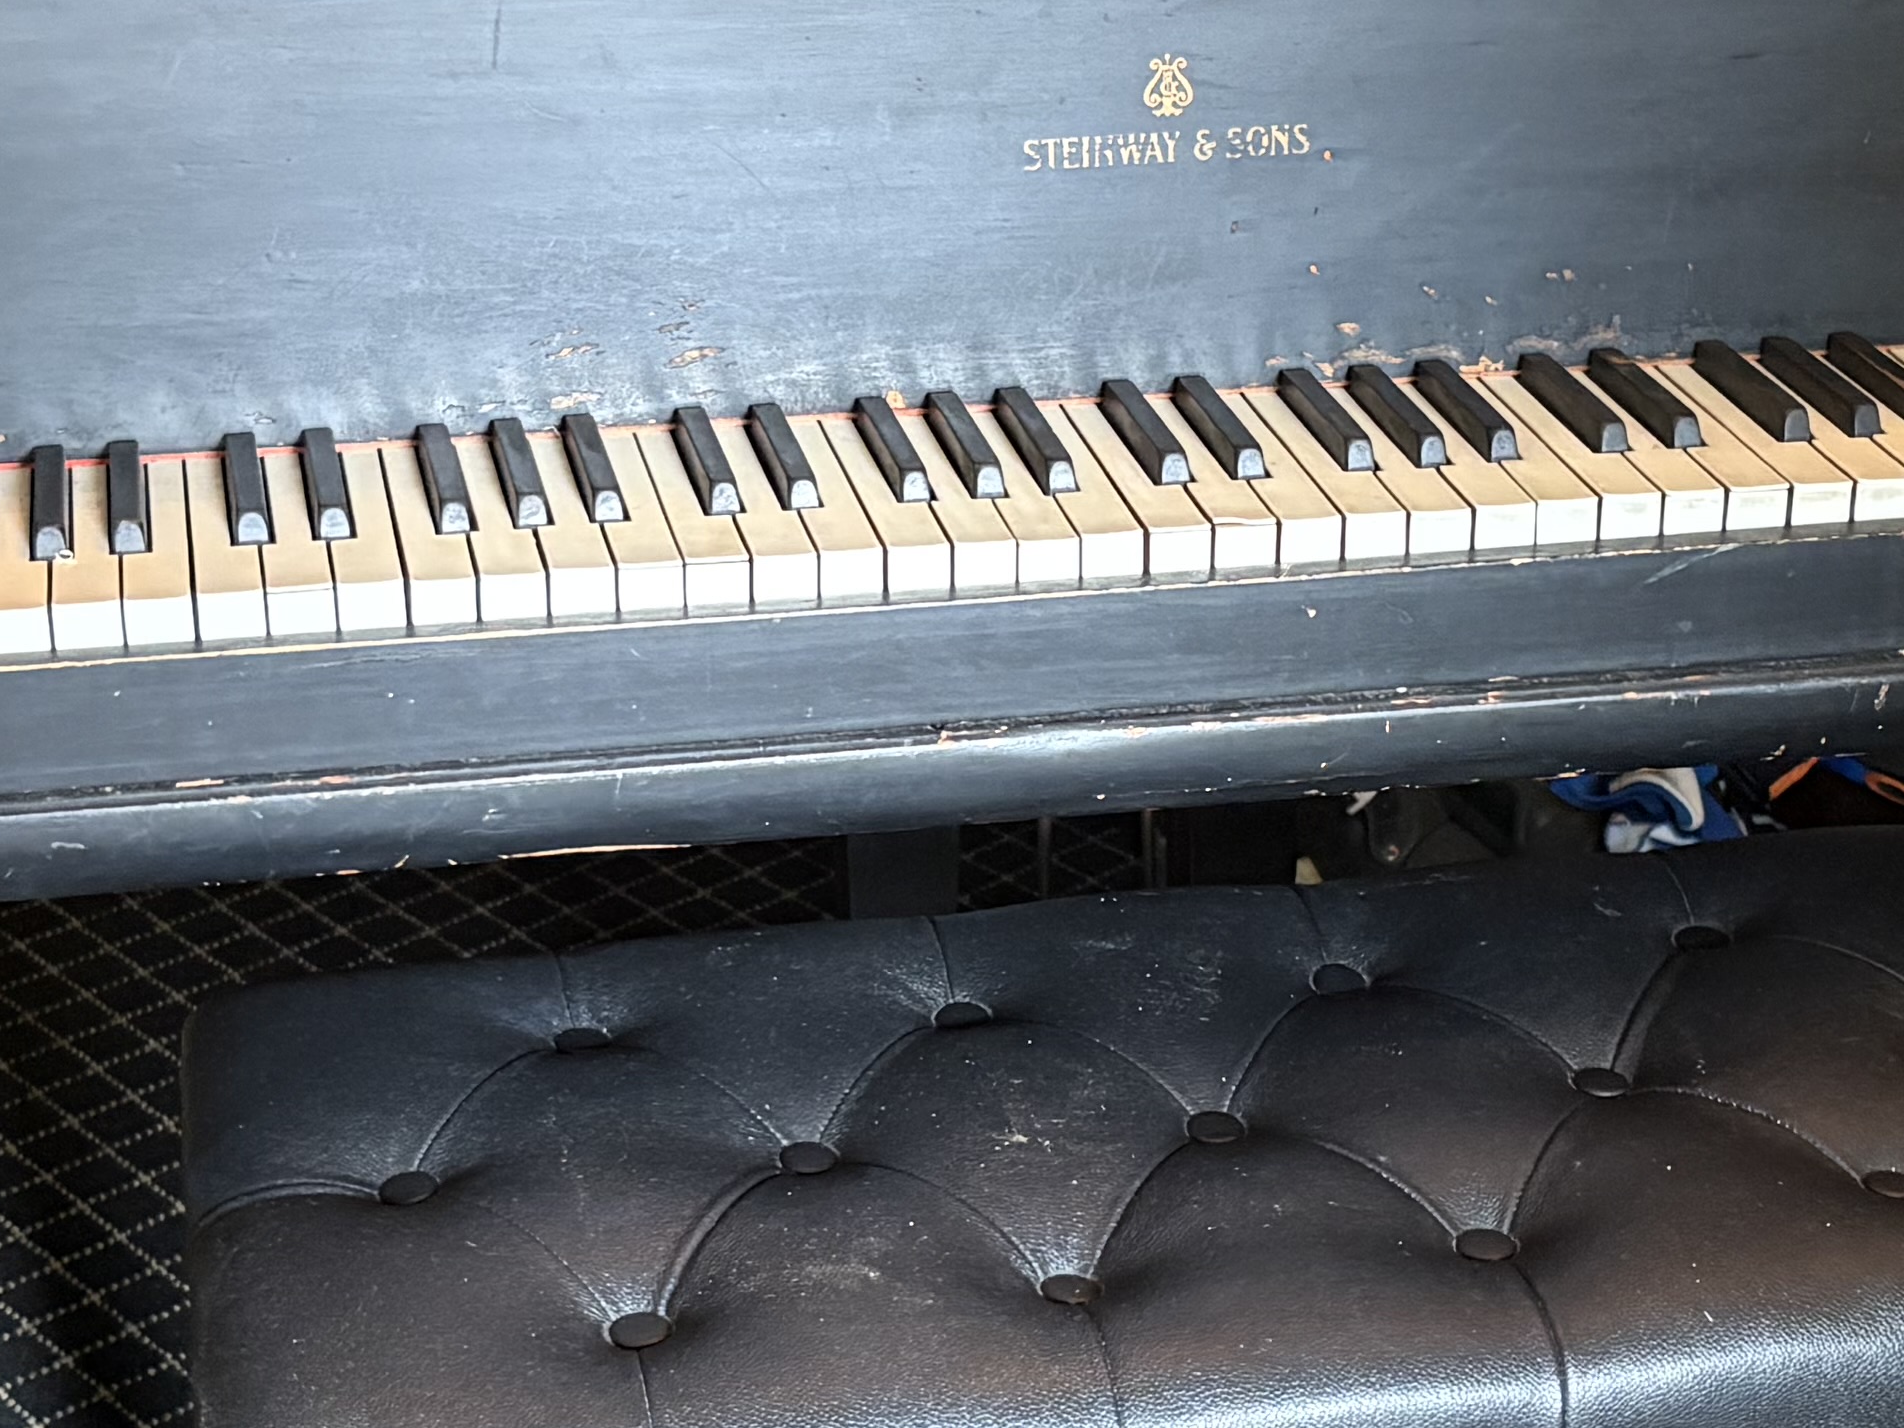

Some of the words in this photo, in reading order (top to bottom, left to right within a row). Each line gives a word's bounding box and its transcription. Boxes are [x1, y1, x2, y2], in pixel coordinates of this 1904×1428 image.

[1023, 131, 1181, 171] STEINWAY
[1193, 129, 1217, 161] &
[1225, 123, 1311, 159] SONS
